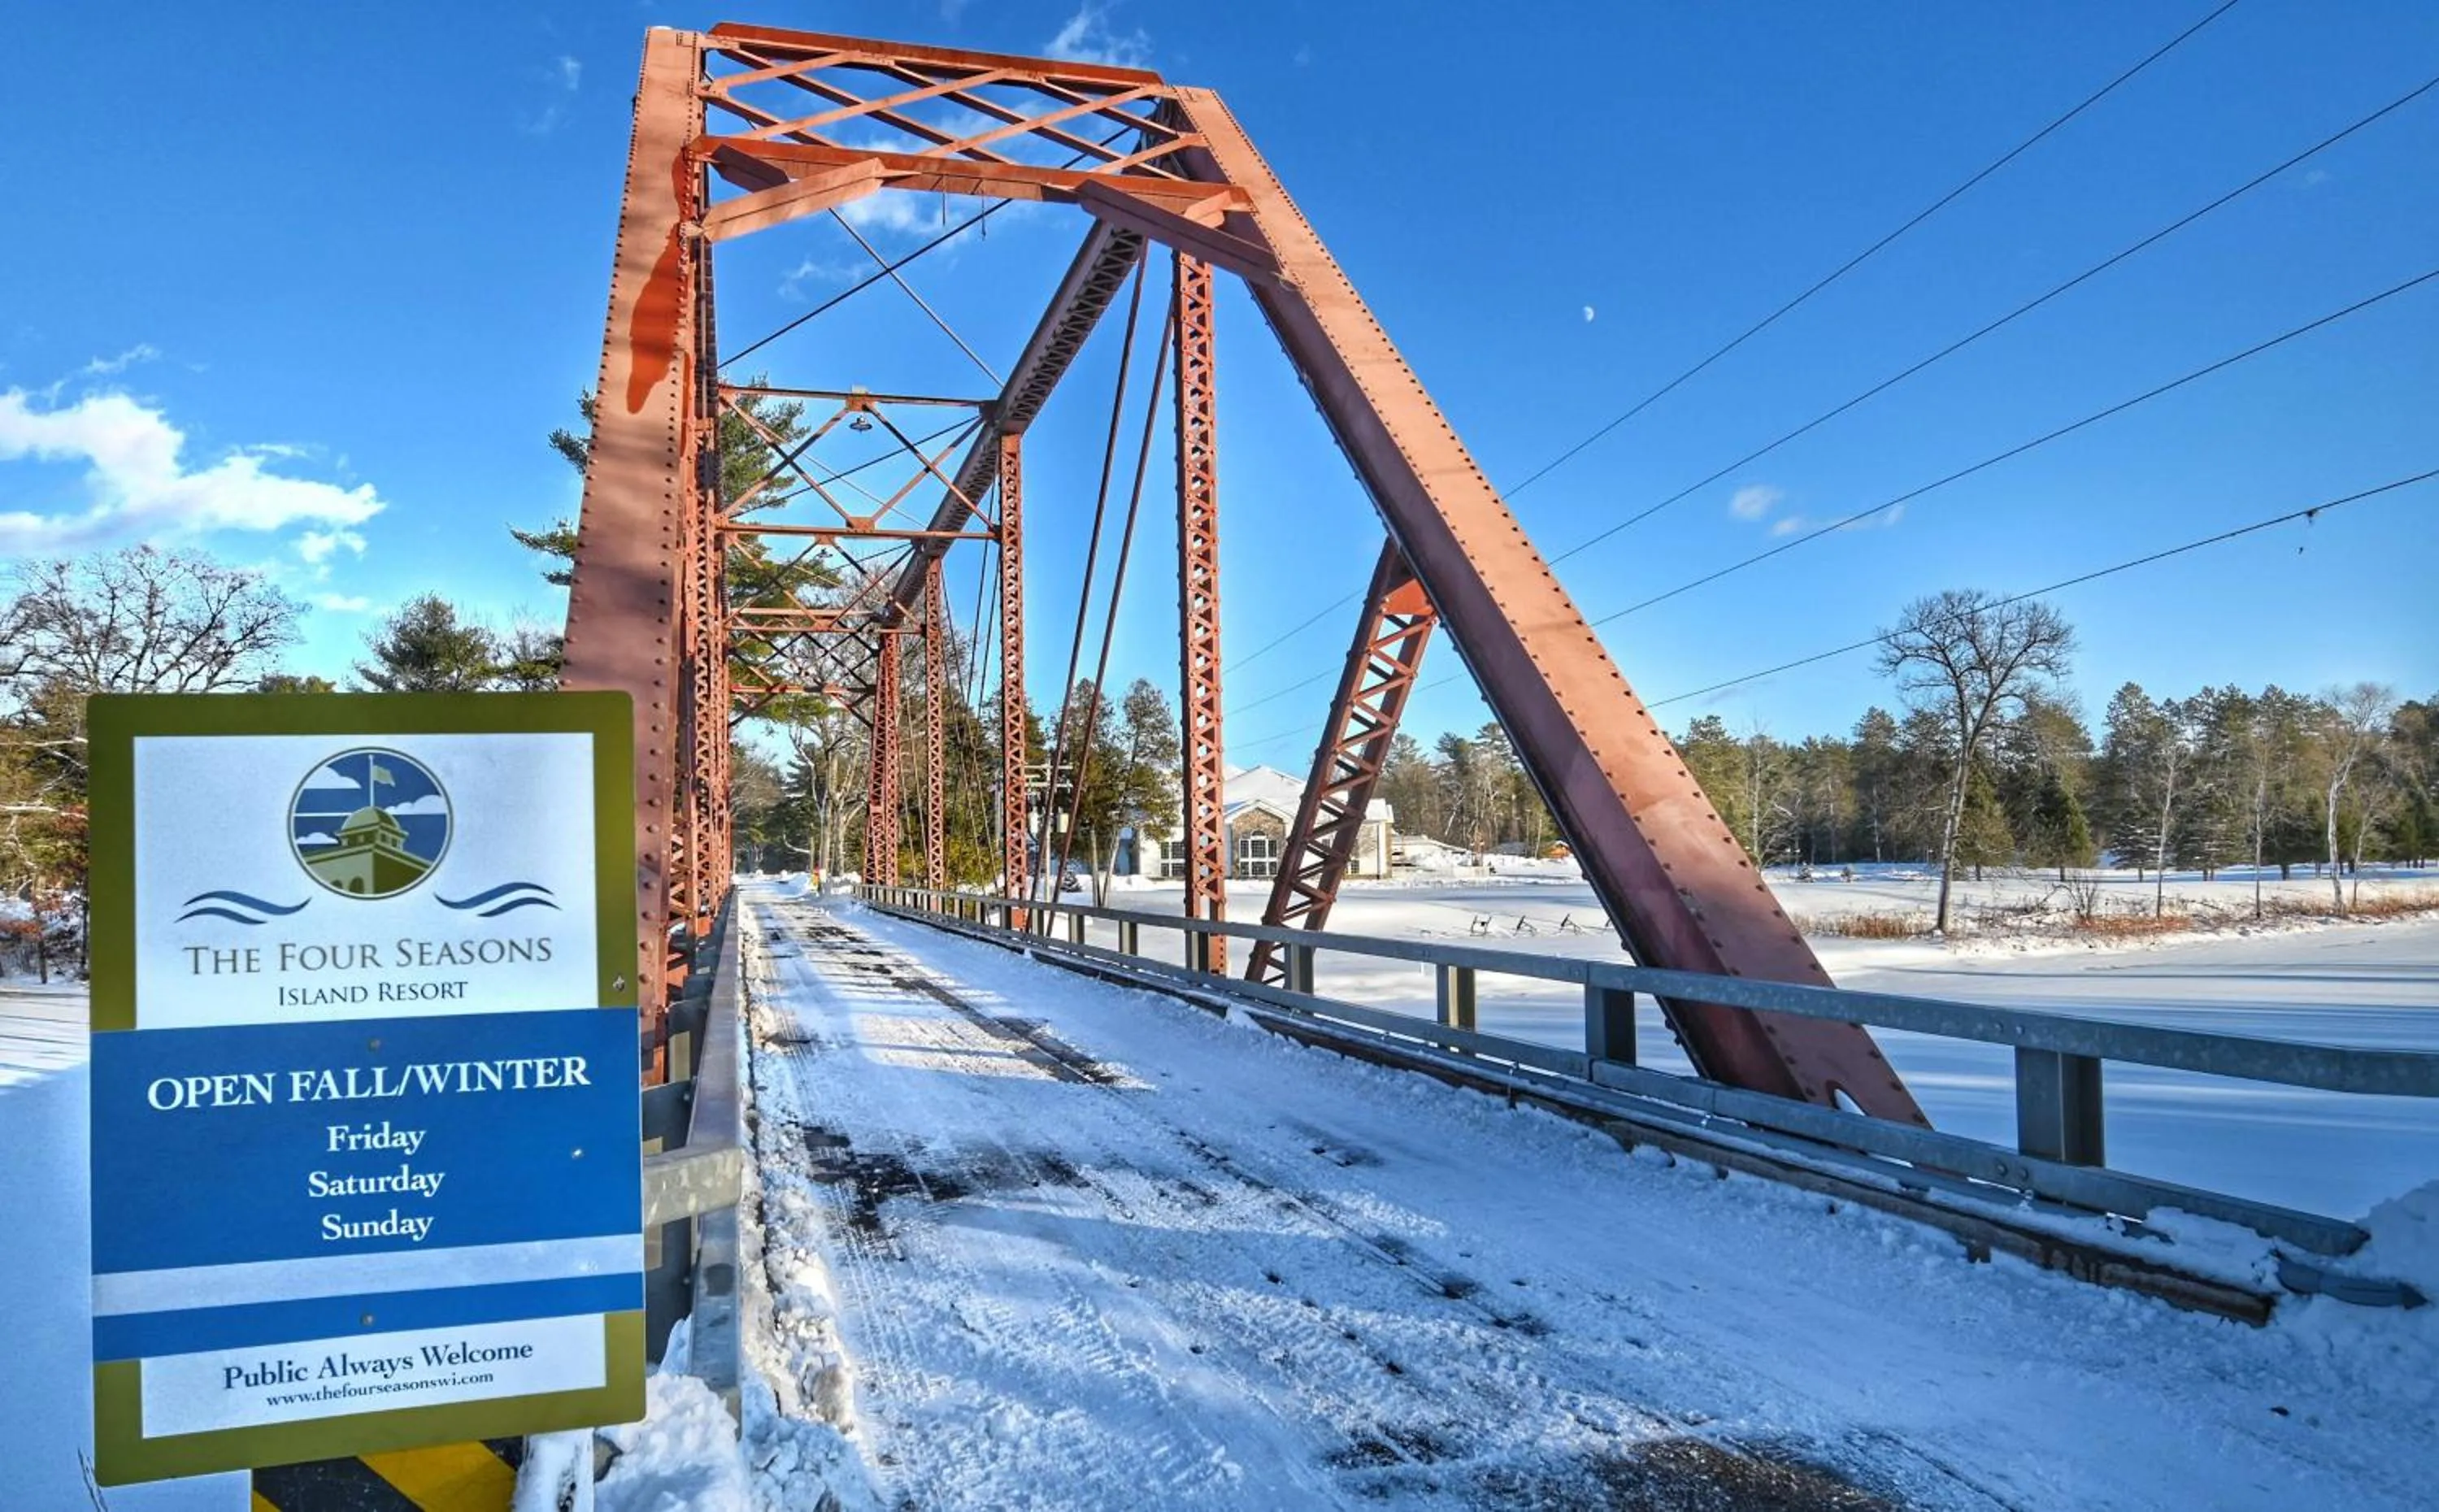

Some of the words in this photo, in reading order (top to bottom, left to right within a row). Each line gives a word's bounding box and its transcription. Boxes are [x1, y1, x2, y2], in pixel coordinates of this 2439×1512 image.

[182, 945, 261, 975] THE
[280, 942, 382, 971] FOUR
[396, 937, 552, 967] SEASONS
[279, 986, 368, 1007] ISLAND
[378, 981, 468, 1003] RESORT
[147, 1072, 275, 1111] OPEN
[289, 1056, 591, 1101] FALL/WINTER
[327, 1121, 426, 1155] Friday
[308, 1163, 446, 1198] Saturday
[322, 1208, 434, 1242] Sunday
[224, 1360, 308, 1389] Public
[317, 1353, 414, 1379] Always
[420, 1341, 533, 1366] Welcome
[266, 1371, 494, 1406] www.thefourseasonswi.com
